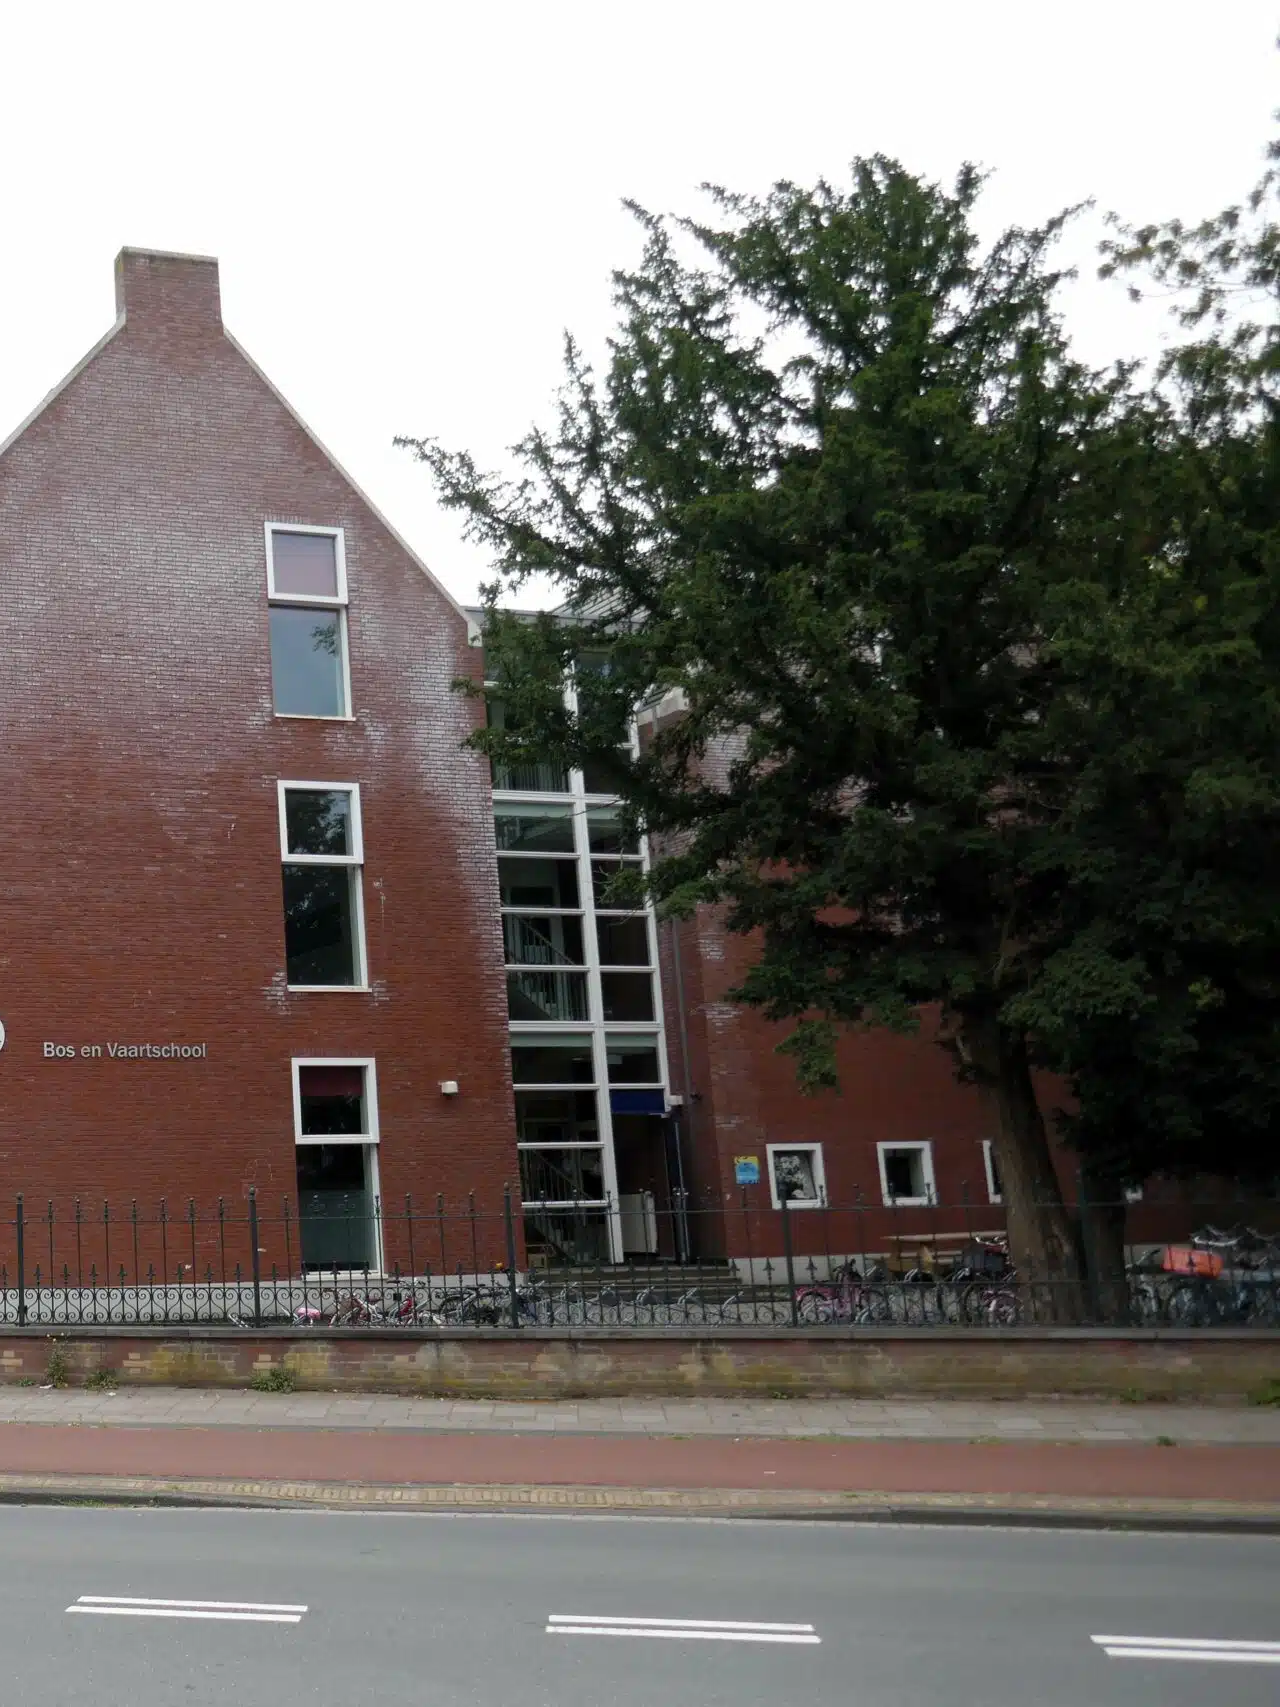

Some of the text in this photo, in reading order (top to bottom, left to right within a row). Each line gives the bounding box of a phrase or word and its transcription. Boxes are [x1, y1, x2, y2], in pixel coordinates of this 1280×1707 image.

[43, 1042, 206, 1058] Bos en Vaartschool
